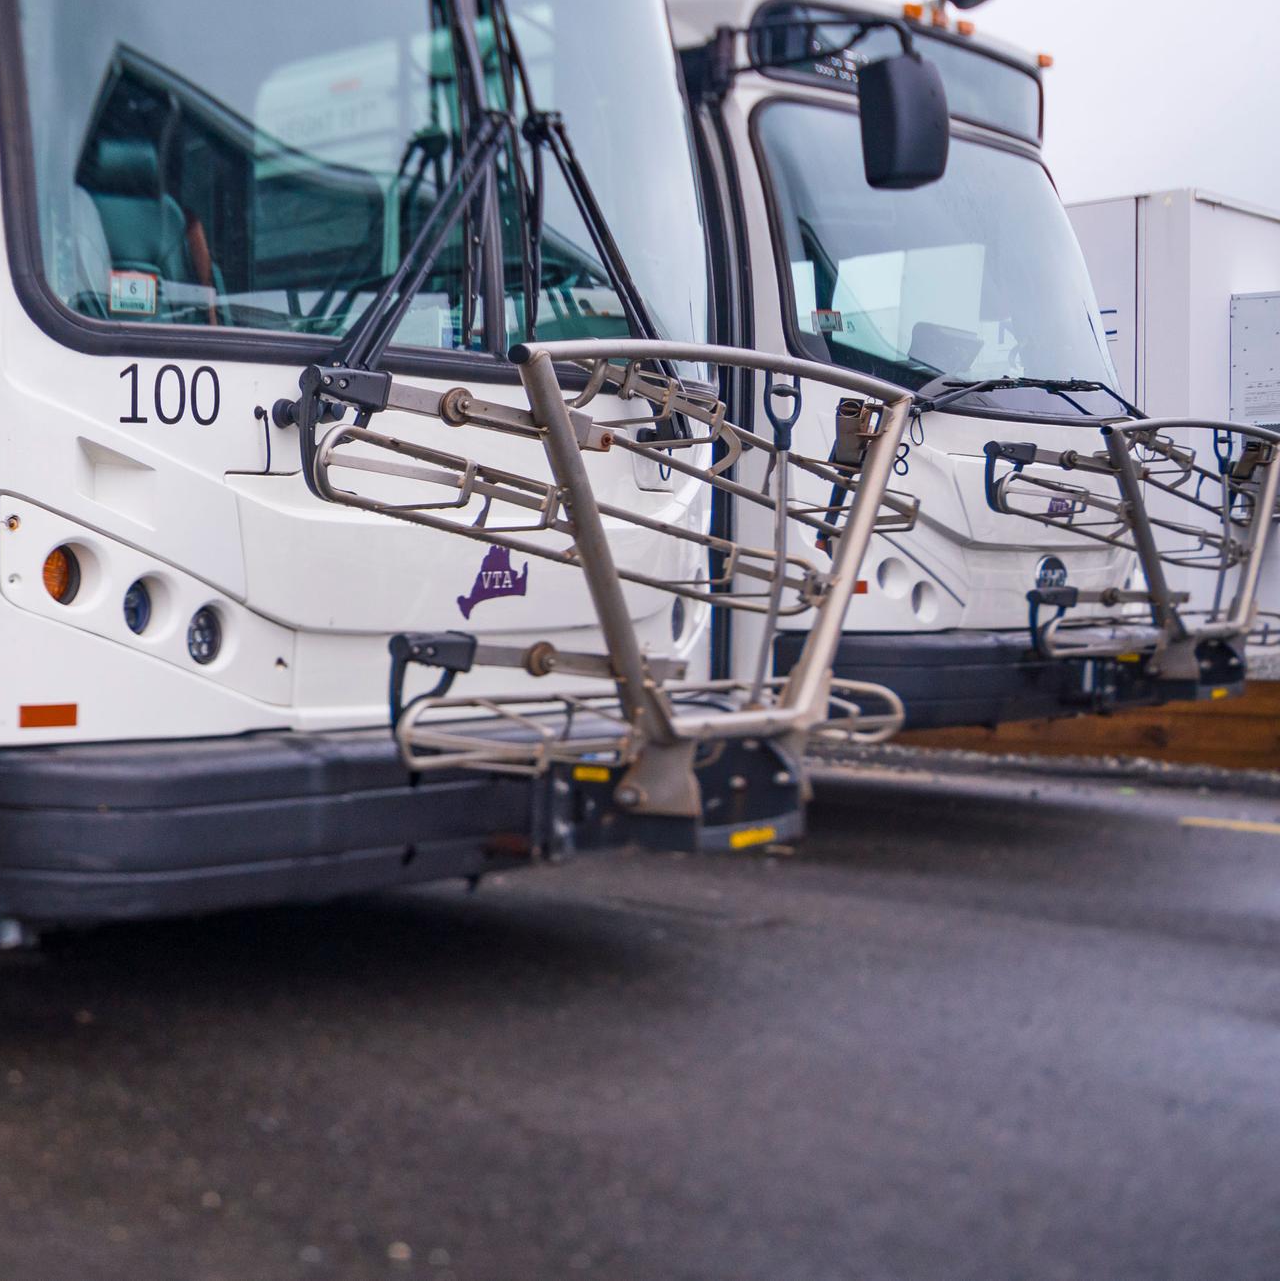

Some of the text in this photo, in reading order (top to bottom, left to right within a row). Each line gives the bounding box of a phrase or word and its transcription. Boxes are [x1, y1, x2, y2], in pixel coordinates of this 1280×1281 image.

[130, 281, 137, 295] 6
[119, 362, 220, 426] 100
[481, 570, 513, 590] VTA
